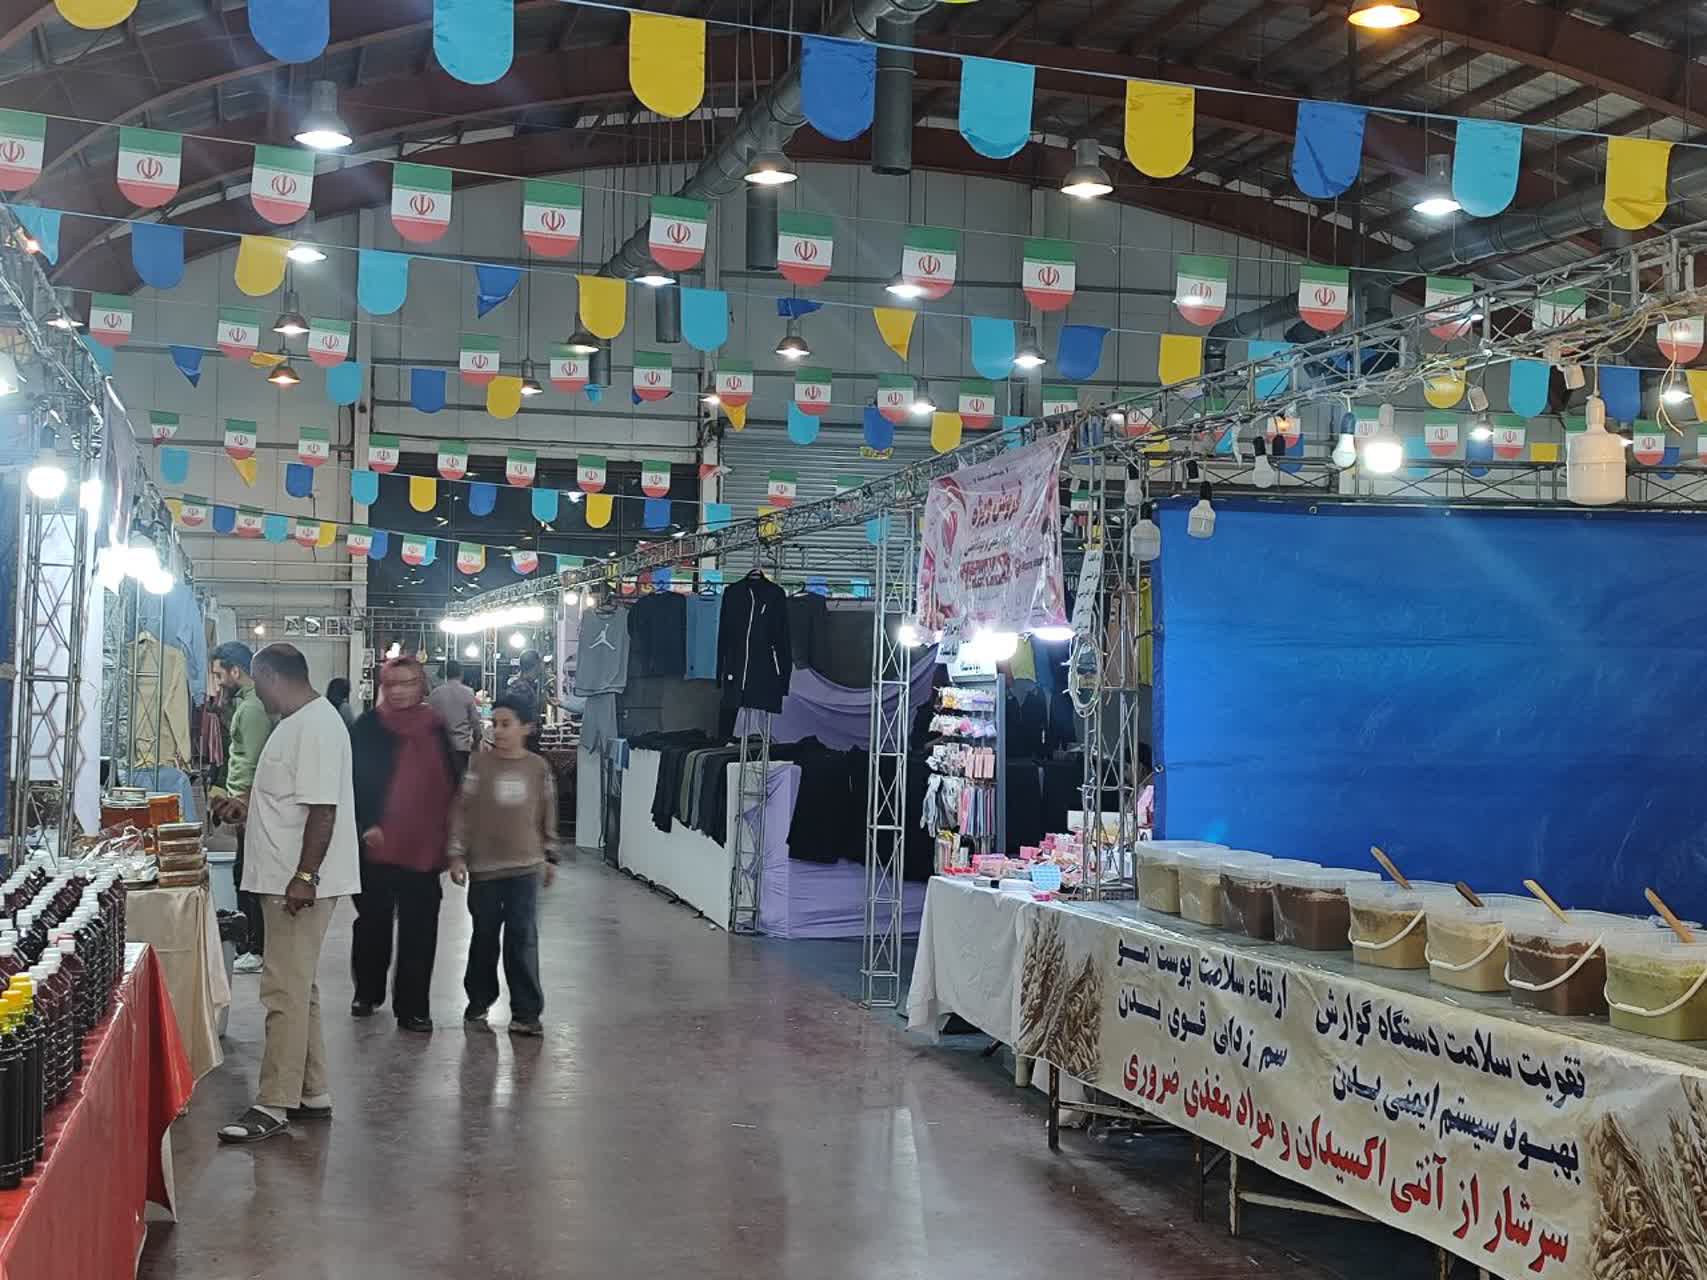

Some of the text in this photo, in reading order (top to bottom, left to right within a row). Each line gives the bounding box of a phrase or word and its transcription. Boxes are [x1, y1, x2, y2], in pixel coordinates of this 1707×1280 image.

[1117, 938, 1288, 1020] ارتقاء سلامت پوست مو
[1118, 988, 1162, 1030] بدن
[1168, 1000, 1207, 1042] قوی
[1316, 988, 1586, 1109] تقویت سلامت دستگاه گوارش
[1123, 1053, 1181, 1105] ضروری
[1258, 1043, 1288, 1073] سم
[1184, 1066, 1232, 1119] مغذی
[1236, 1086, 1275, 1150] مواد
[1279, 1120, 1291, 1161] و
[1295, 1113, 1387, 1187] اکسیدان
[1332, 1064, 1582, 1186] بهبود سیستم ایمنی بدن
[1390, 1152, 1447, 1214] آنتی
[1453, 1172, 1480, 1240] از
